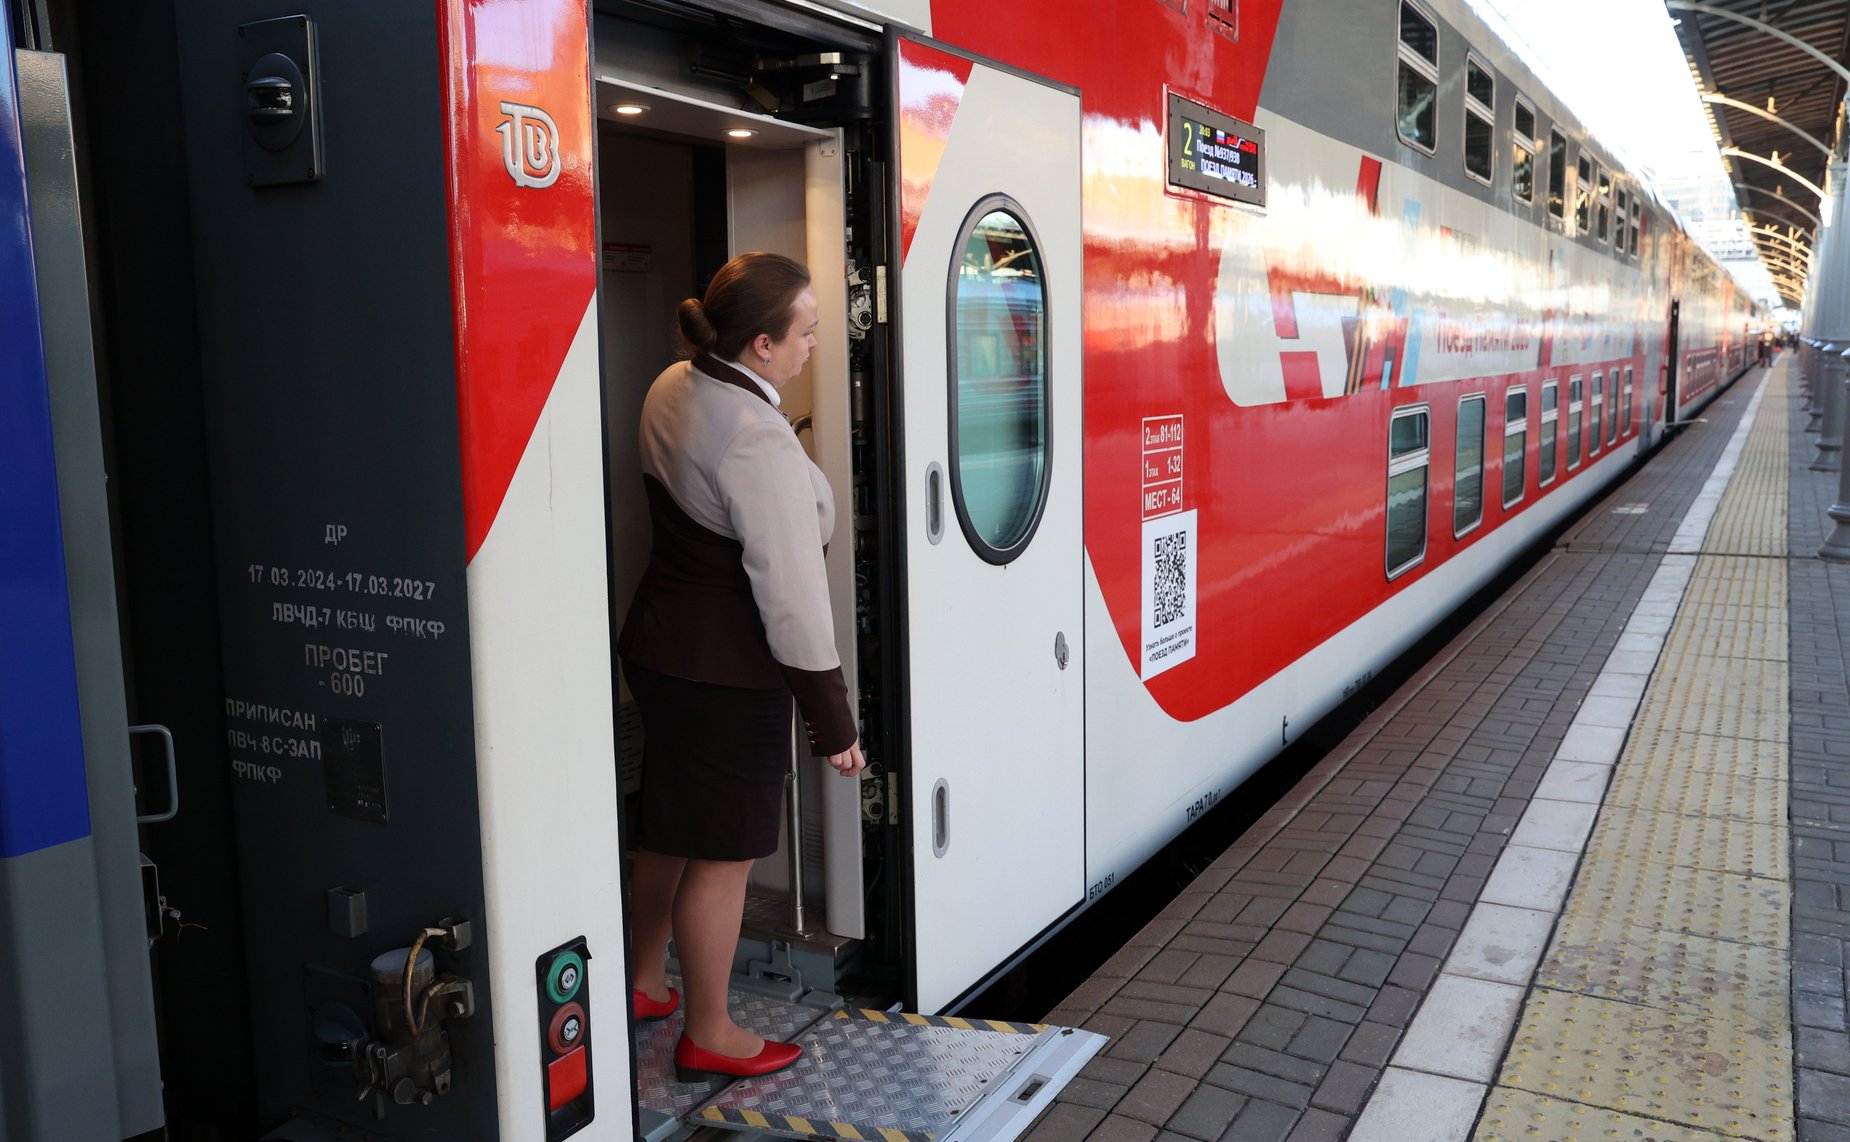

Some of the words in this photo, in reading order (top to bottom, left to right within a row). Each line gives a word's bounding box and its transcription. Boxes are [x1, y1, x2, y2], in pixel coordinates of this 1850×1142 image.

[1183, 122, 1193, 156] 2
[1197, 139, 1214, 158] Поезд
[1160, 423, 1181, 443] 81-112
[1167, 455, 1181, 475] 1-32
[1145, 489, 1168, 511] МЕСТ
[324, 524, 348, 545] ДР
[272, 602, 331, 629] ЛВЧД-7
[385, 614, 445, 640] ФПКФ
[304, 644, 389, 676] ПРОБЕГ
[330, 672, 365, 698] 600
[225, 698, 316, 732] ПРИПИСАН
[232, 759, 282, 784] ФПКФ
[1089, 881, 1103, 900] БТО
